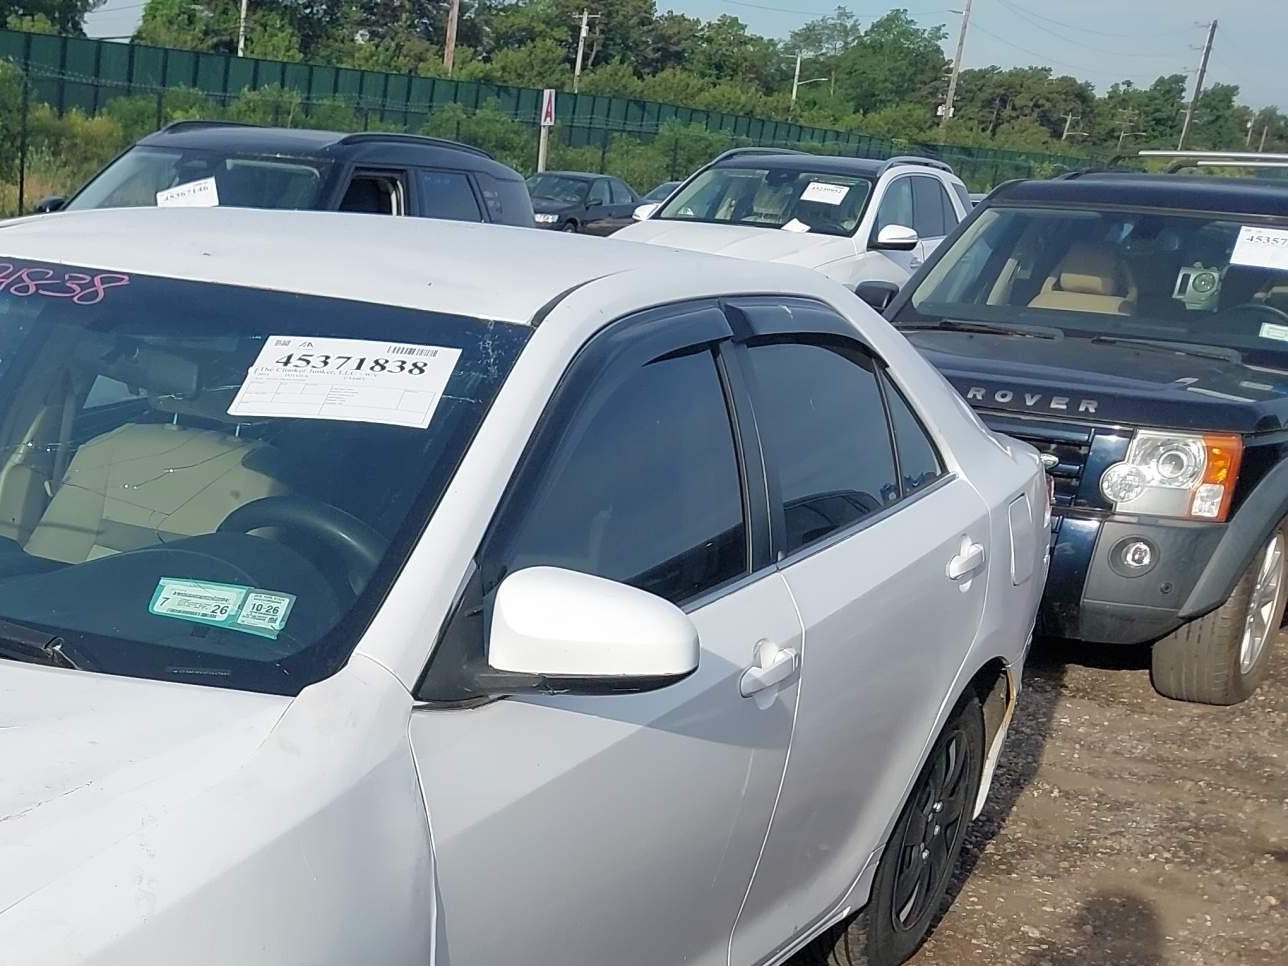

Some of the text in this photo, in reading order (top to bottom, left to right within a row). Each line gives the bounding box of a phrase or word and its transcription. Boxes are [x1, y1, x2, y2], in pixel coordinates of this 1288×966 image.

[543, 90, 553, 123] A
[275, 352, 428, 376] 45371838
[967, 387, 1099, 413] ROVER
[159, 597, 170, 606] 7
[210, 604, 229, 615] 26
[252, 603, 280, 615] 10-26
